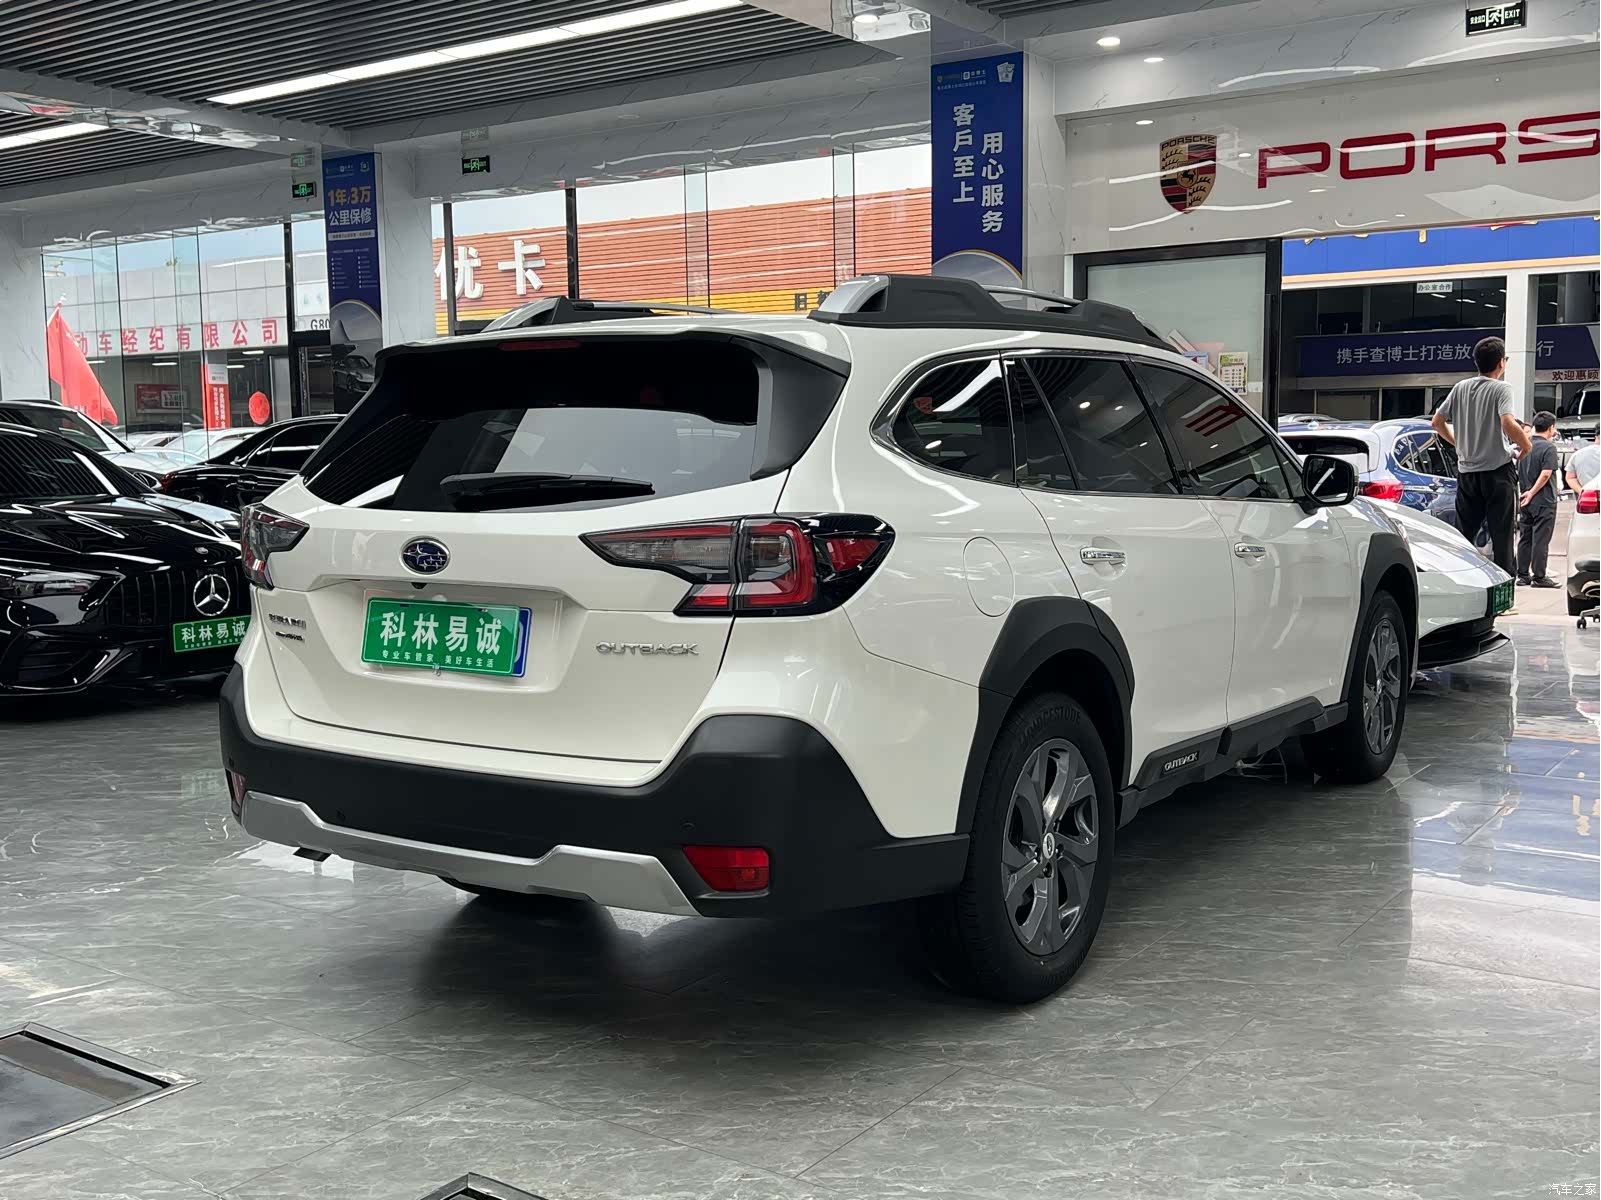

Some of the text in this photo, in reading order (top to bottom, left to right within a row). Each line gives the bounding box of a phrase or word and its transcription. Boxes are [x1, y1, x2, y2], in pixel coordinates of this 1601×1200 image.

[1504, 9, 1520, 19] EXIT
[1161, 135, 1216, 151] PORSCHE
[1257, 110, 1600, 188] PORS
[981, 131, 1004, 233] 用心服务
[329, 207, 372, 226] 公里保修
[434, 239, 546, 301] 优卡
[1551, 369, 1599, 381] 欢迎惠顾
[181, 621, 246, 643] 科林易诚
[380, 611, 502, 656] 科林易诚
[596, 641, 699, 656] OUTBACK
[382, 649, 494, 668] 专业车管家 美好车生活
[1164, 752, 1198, 771] OUTBACK
